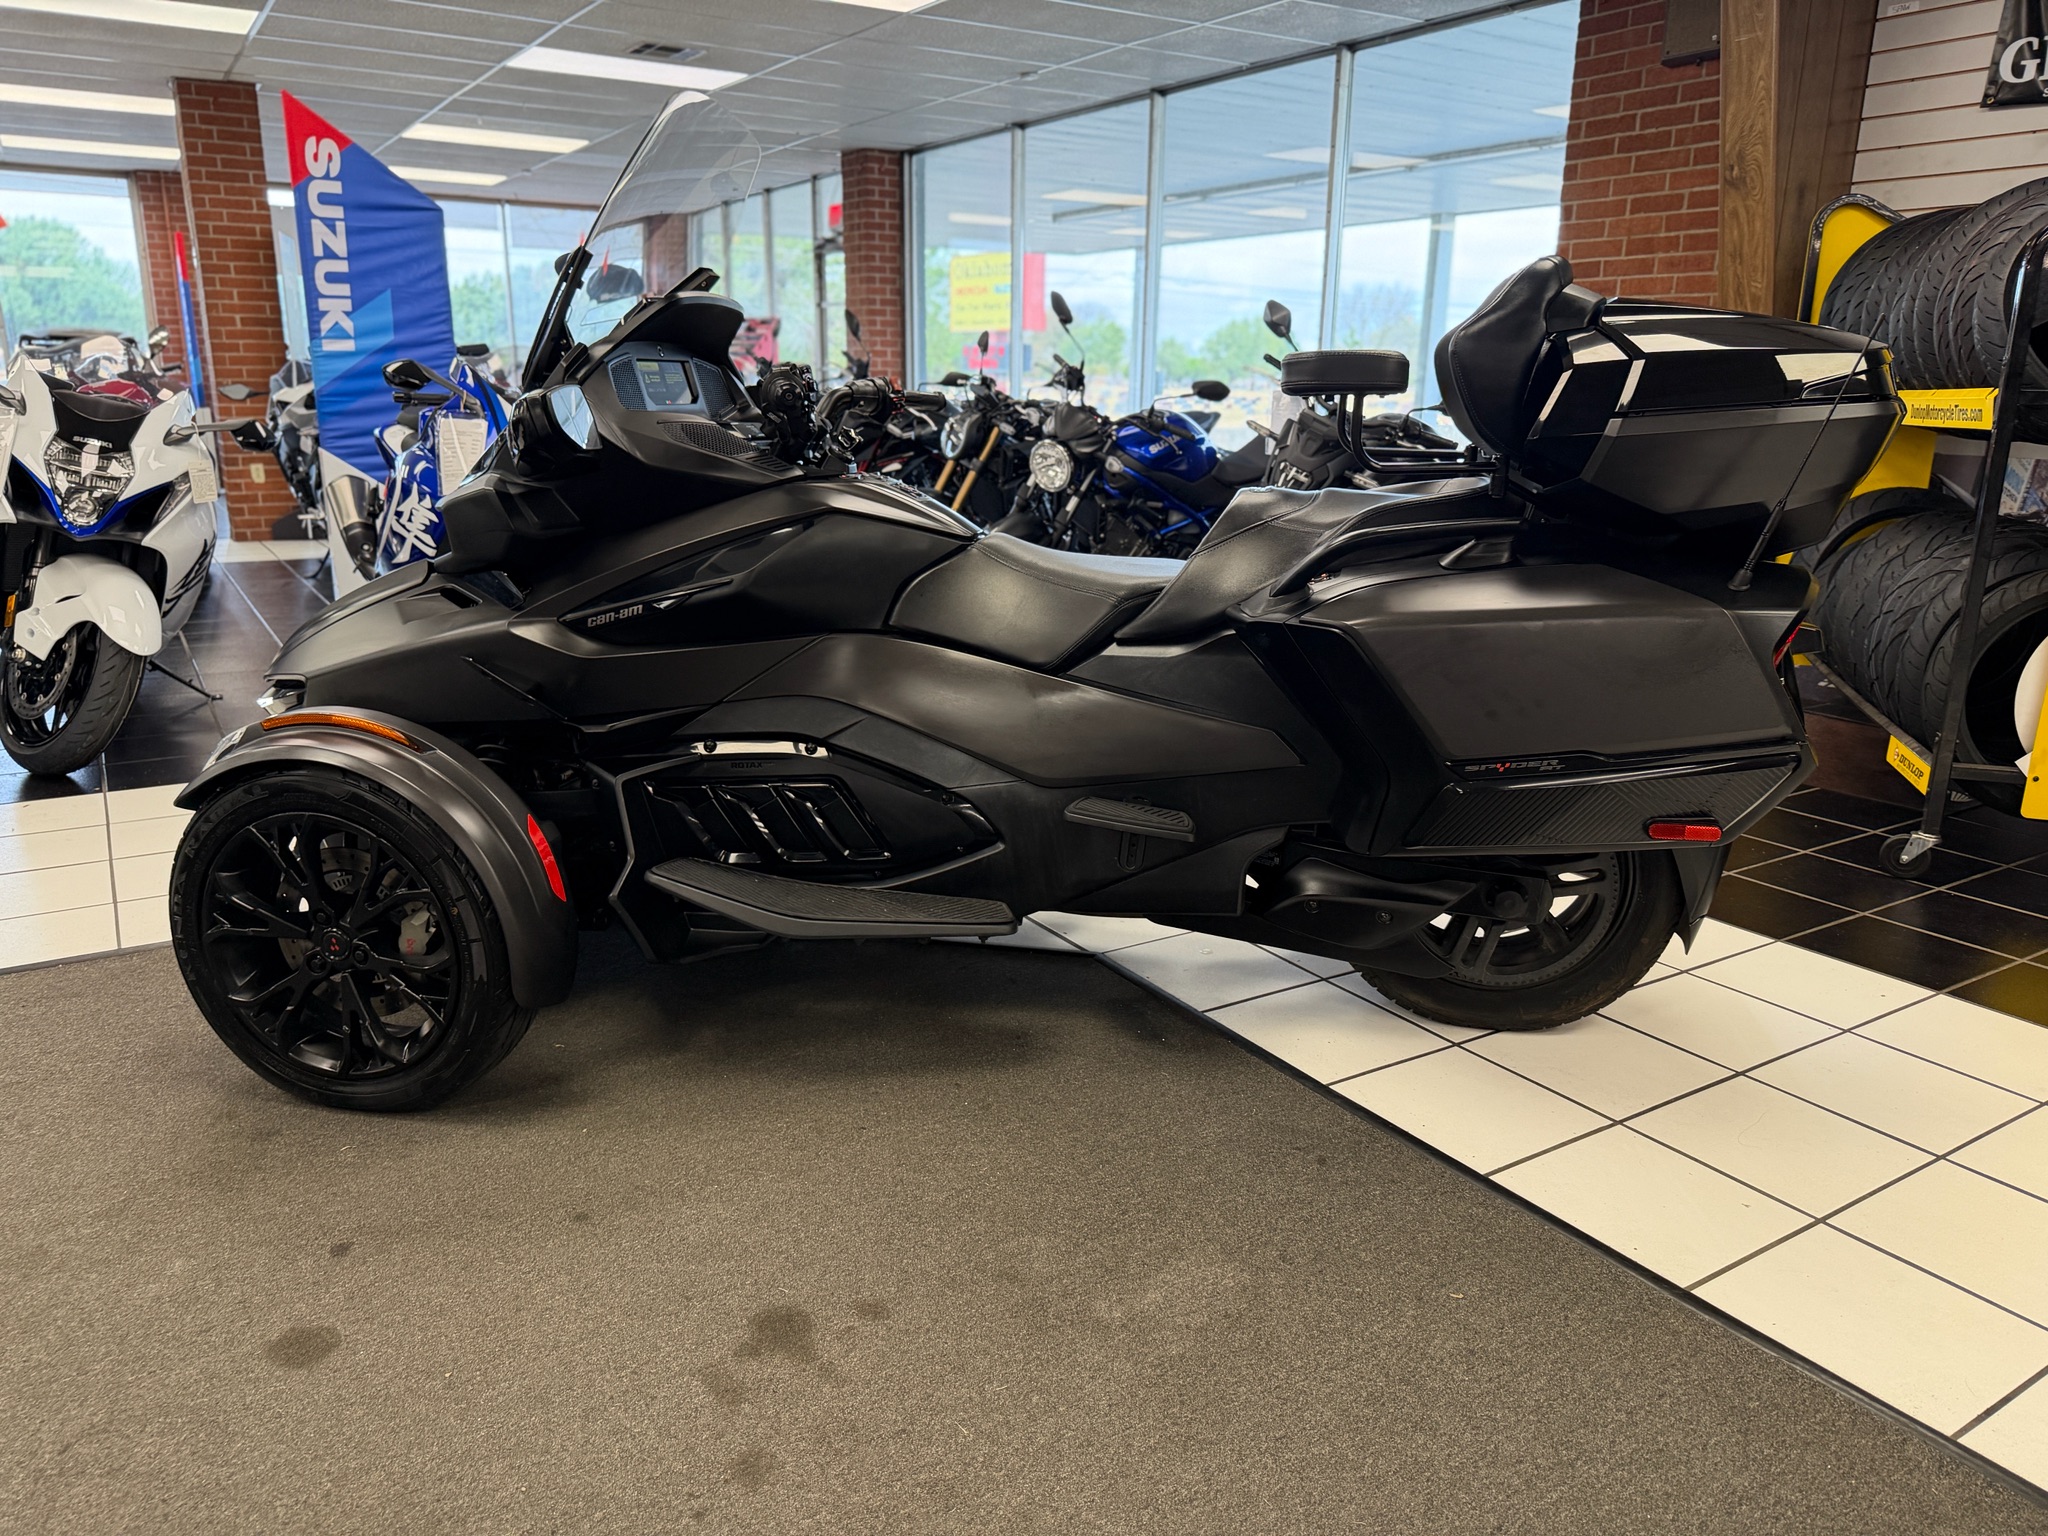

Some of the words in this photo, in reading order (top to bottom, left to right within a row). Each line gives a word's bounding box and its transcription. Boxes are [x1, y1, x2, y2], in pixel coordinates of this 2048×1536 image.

[304, 136, 356, 352] SUZUKI
[1910, 403, 1983, 424] DunlopMotorcycleTires.com
[72, 435, 113, 449] SUZUKI
[587, 604, 643, 627] can-am
[1898, 753, 1924, 780] DUNLOP
